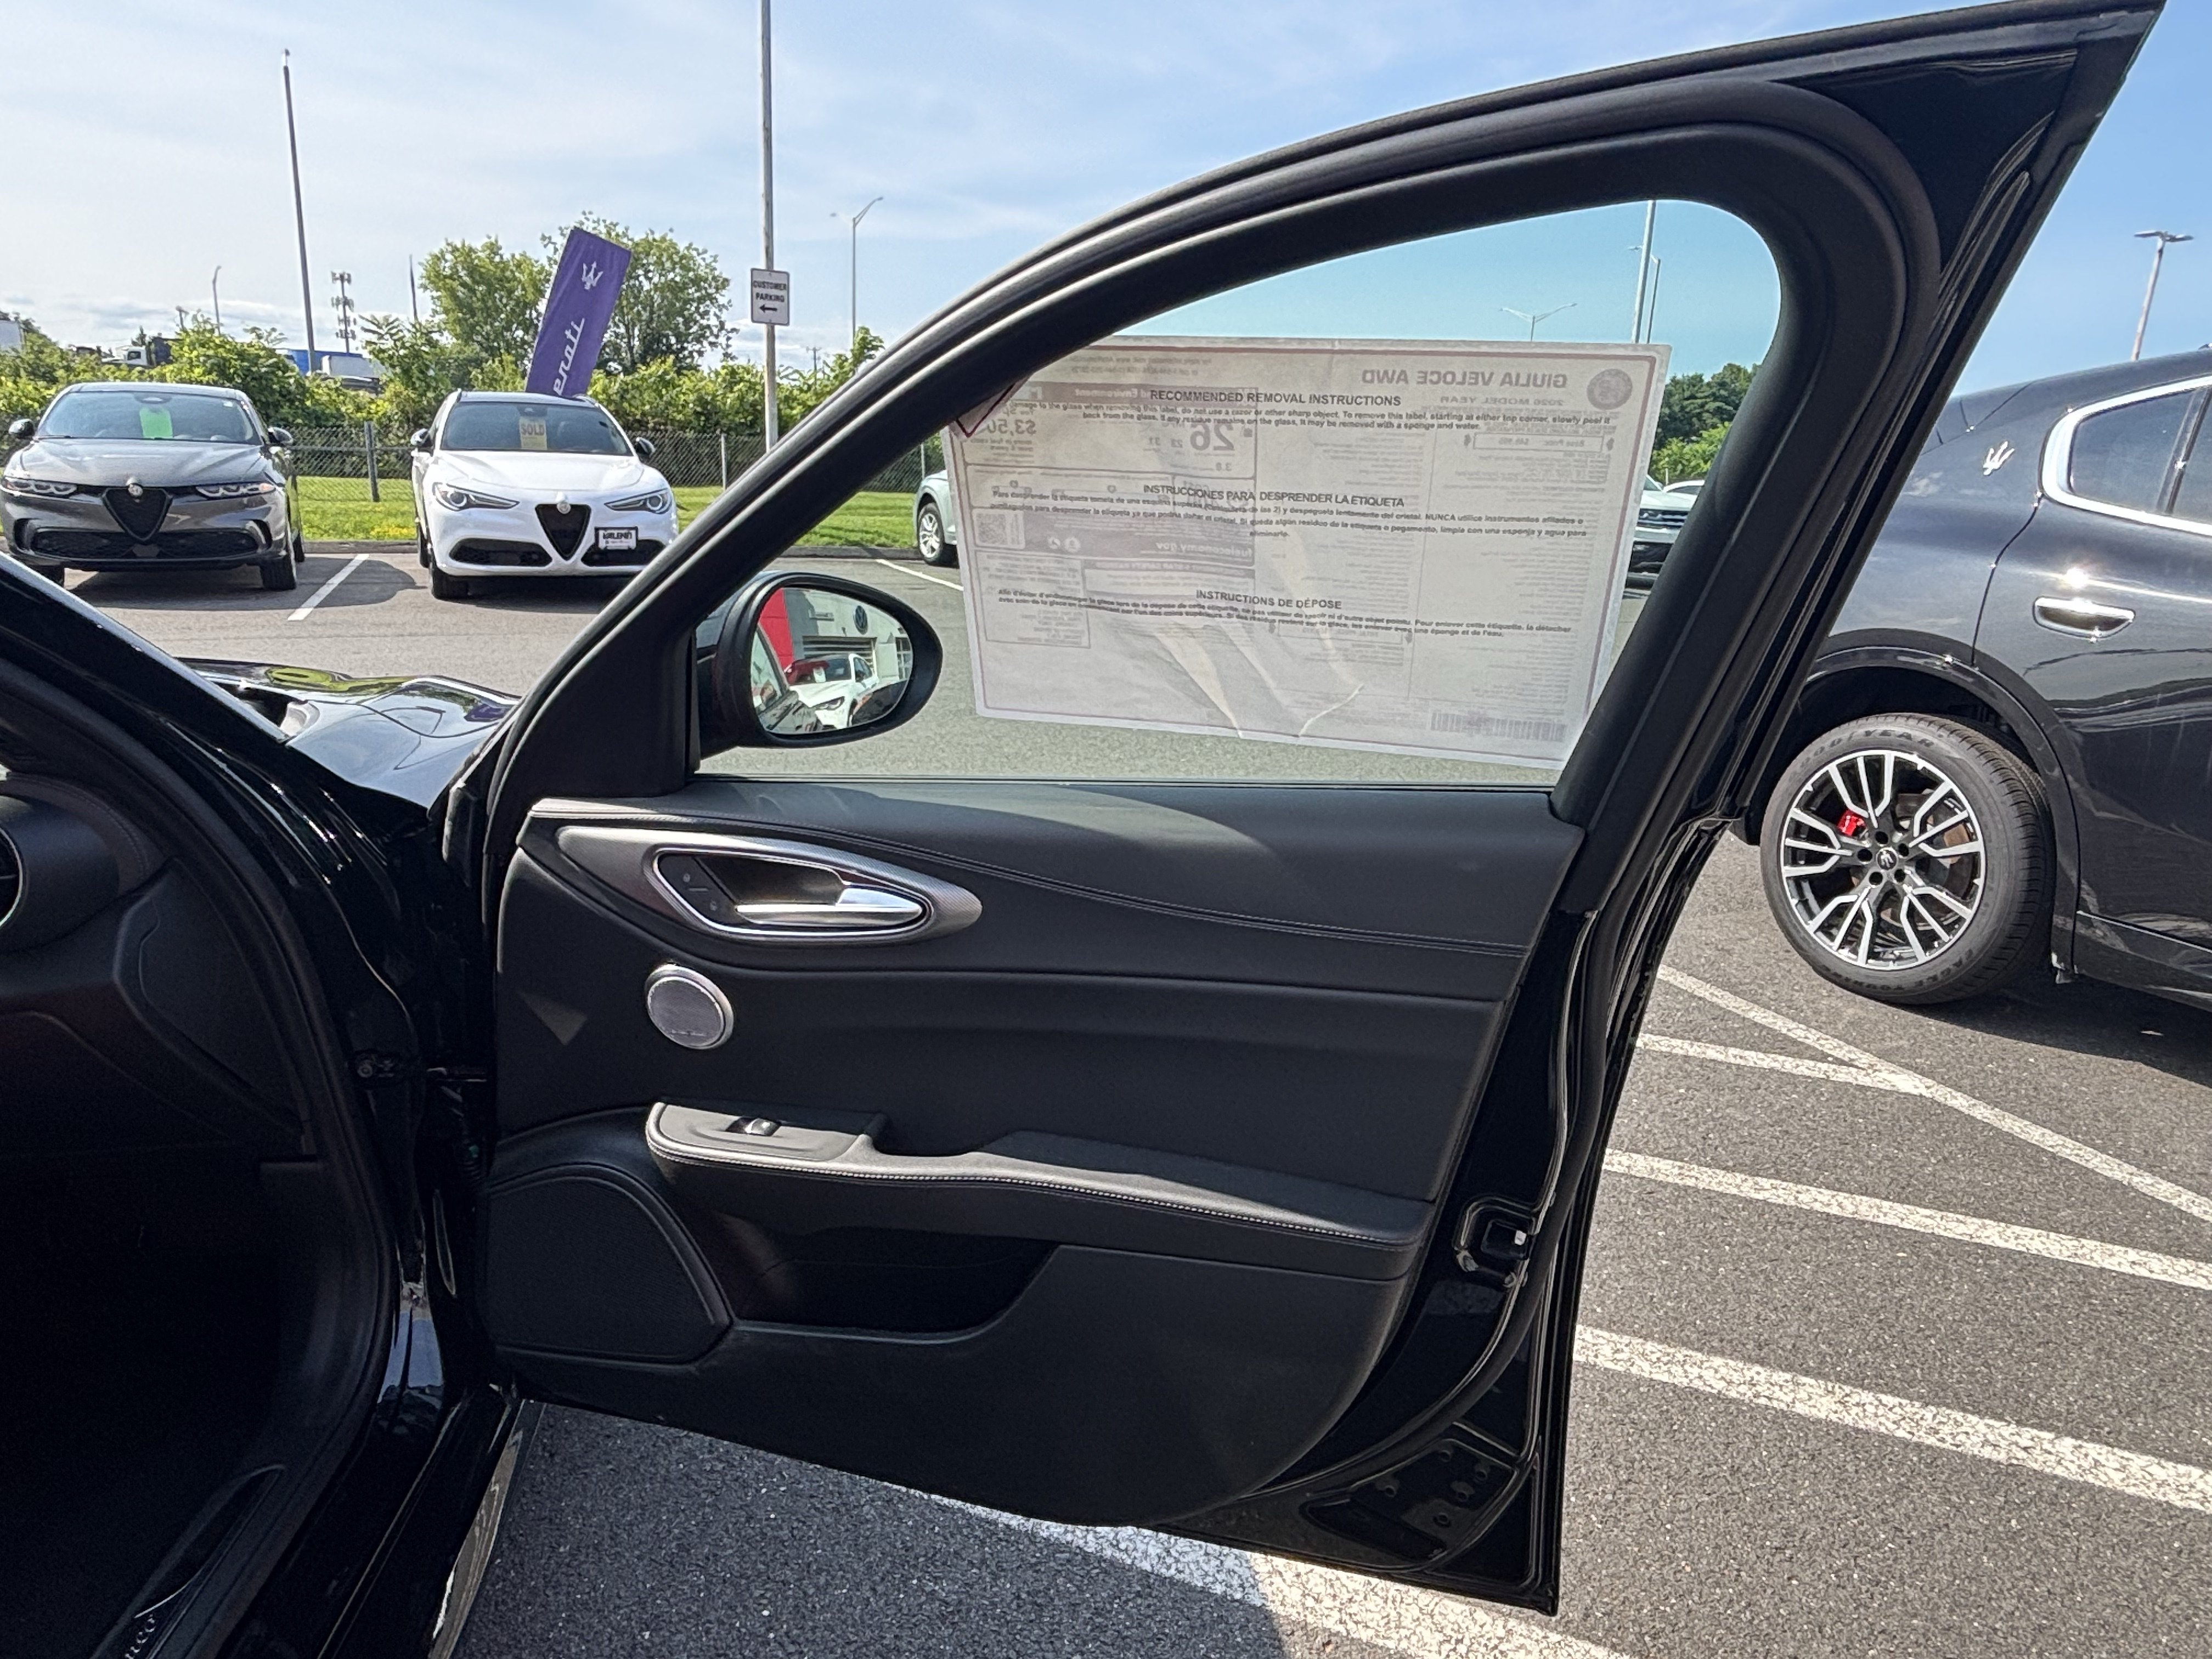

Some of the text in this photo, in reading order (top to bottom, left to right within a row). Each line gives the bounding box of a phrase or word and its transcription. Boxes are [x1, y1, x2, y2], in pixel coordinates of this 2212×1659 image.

[753, 280, 787, 290] CUSTOMER
[755, 292, 785, 303] PARKING
[1150, 390, 1401, 407] RECOMMENDED REMOVAL INSTRUCTIONS
[1288, 409, 1311, 418] sharp
[1430, 413, 1463, 422] starting
[1552, 416, 1580, 425] slowly
[1583, 416, 1601, 425] peel
[521, 424, 545, 436] SOLD
[1143, 484, 1223, 500] INSTRUCCIONES
[1226, 489, 1256, 501] PARA
[1260, 490, 1332, 504] DESPRENDER
[1335, 494, 1348, 505] LA
[1351, 494, 1404, 507] ETIQUETA
[1425, 513, 1455, 521] NUNCA
[1196, 589, 1342, 611] INSTRUCTIONS DE DÉPOSE
